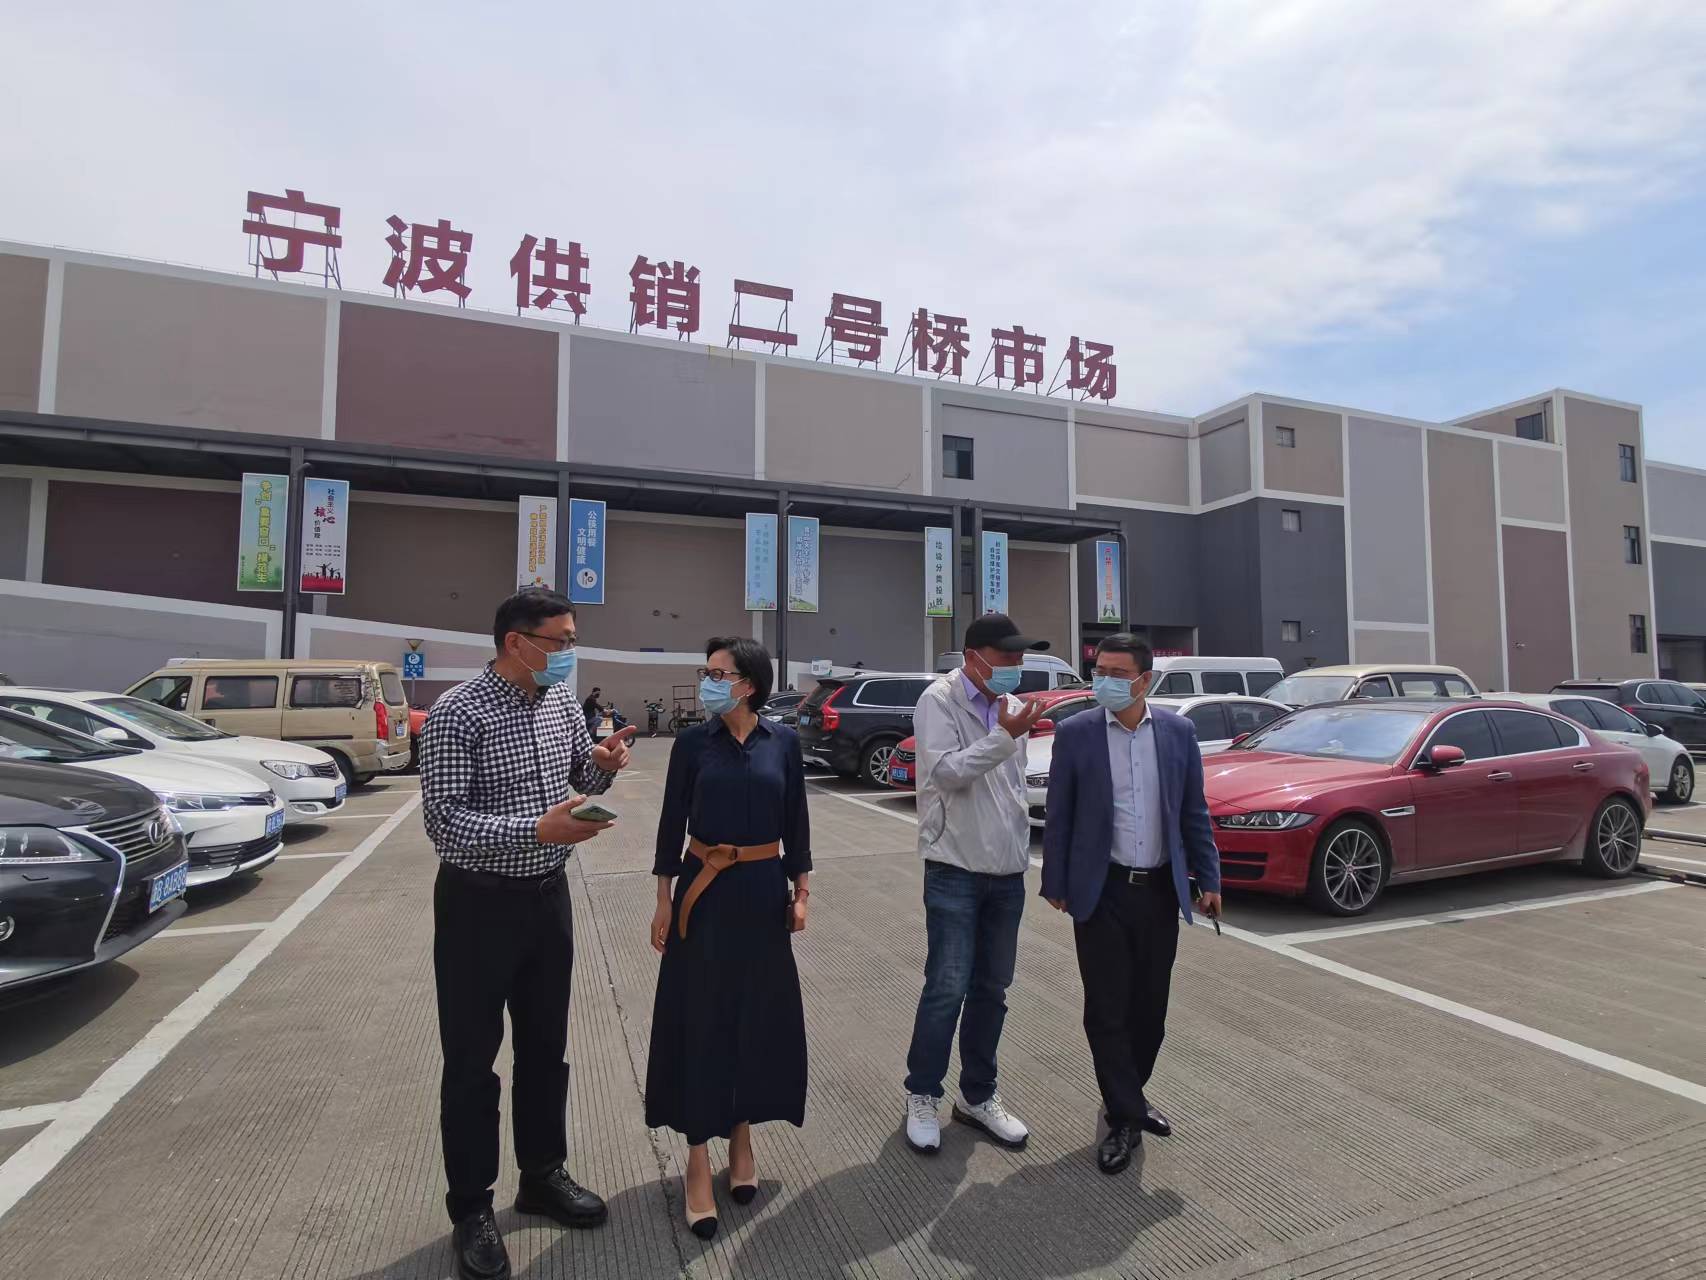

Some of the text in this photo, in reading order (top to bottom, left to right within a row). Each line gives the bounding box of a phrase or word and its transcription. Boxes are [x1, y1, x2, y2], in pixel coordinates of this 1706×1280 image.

[242, 189, 1117, 401] 宁波供销二号桥市场
[576, 528, 586, 565] 文明健康
[935, 541, 944, 606] 垃圾分类投放
